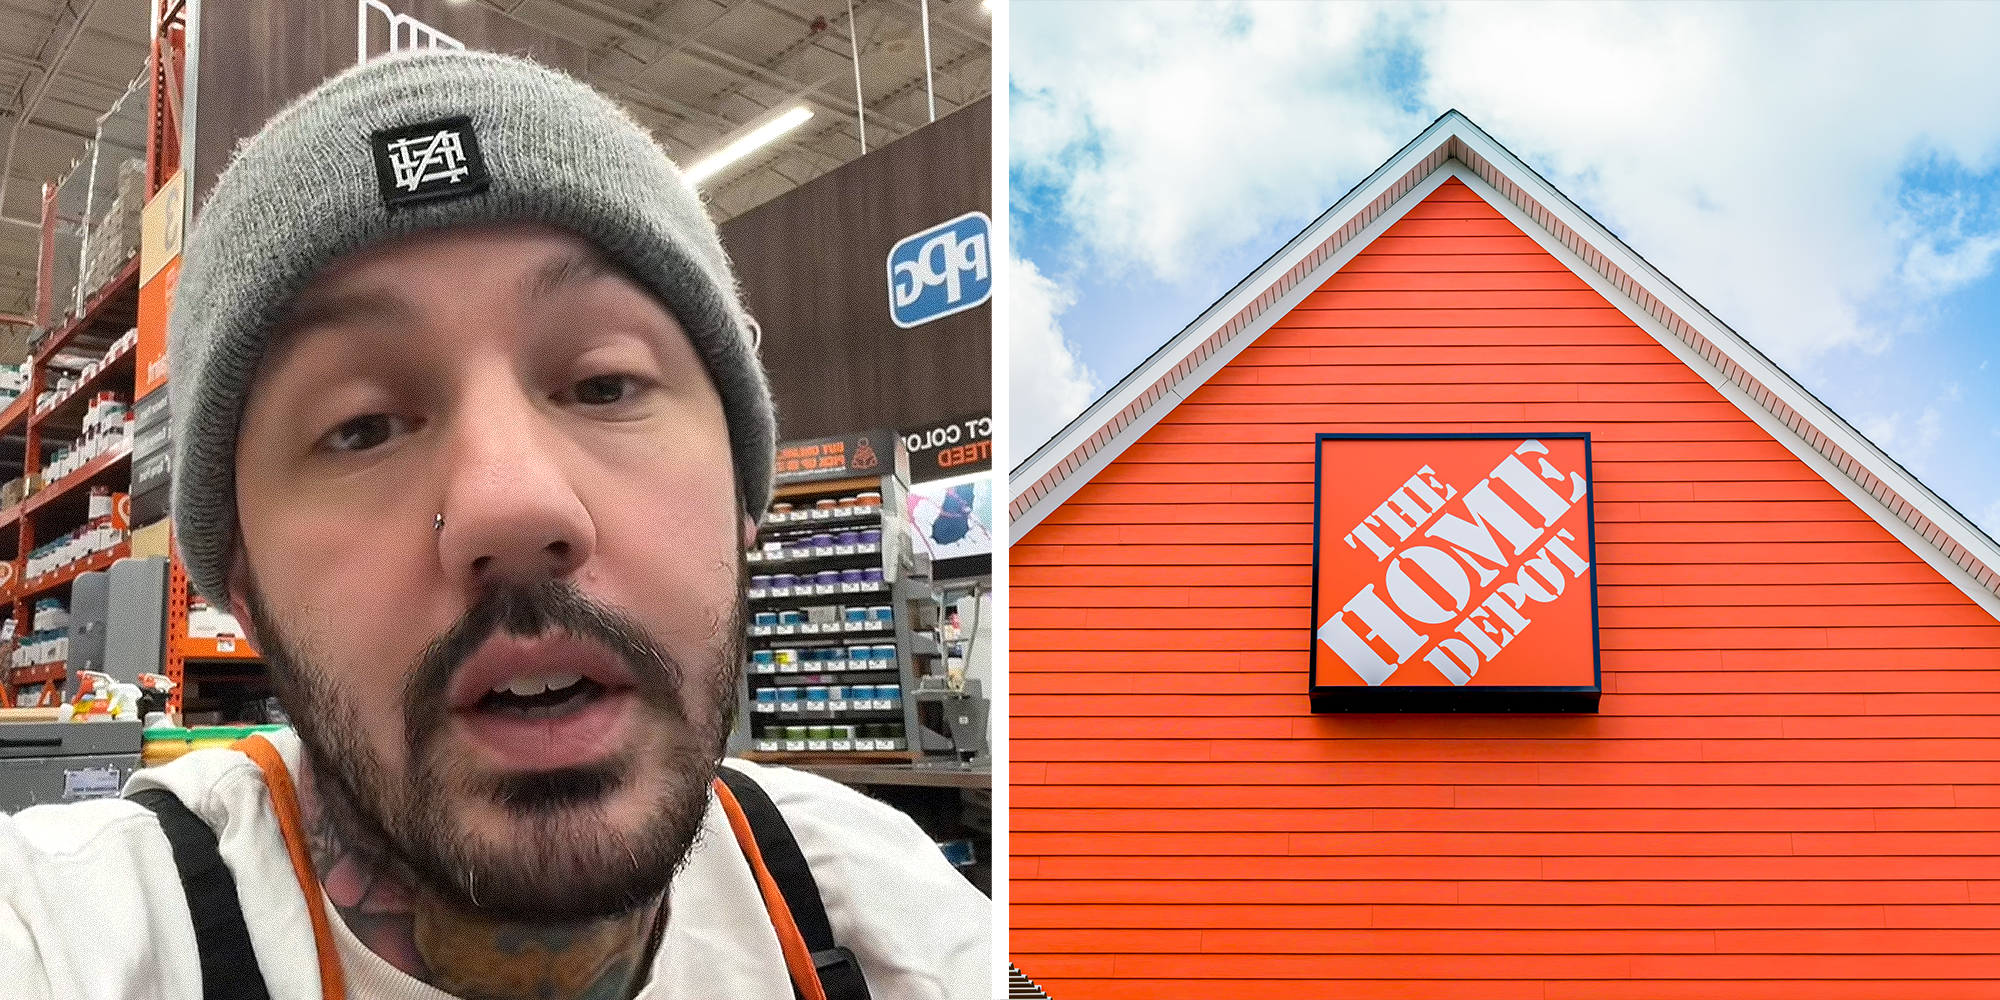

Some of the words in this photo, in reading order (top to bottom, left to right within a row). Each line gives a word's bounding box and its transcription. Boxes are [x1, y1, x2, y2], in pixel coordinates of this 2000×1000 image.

[1316, 438, 1588, 687] HOME
[1343, 464, 1458, 562] THE
[1422, 527, 1590, 687] DEPOT
